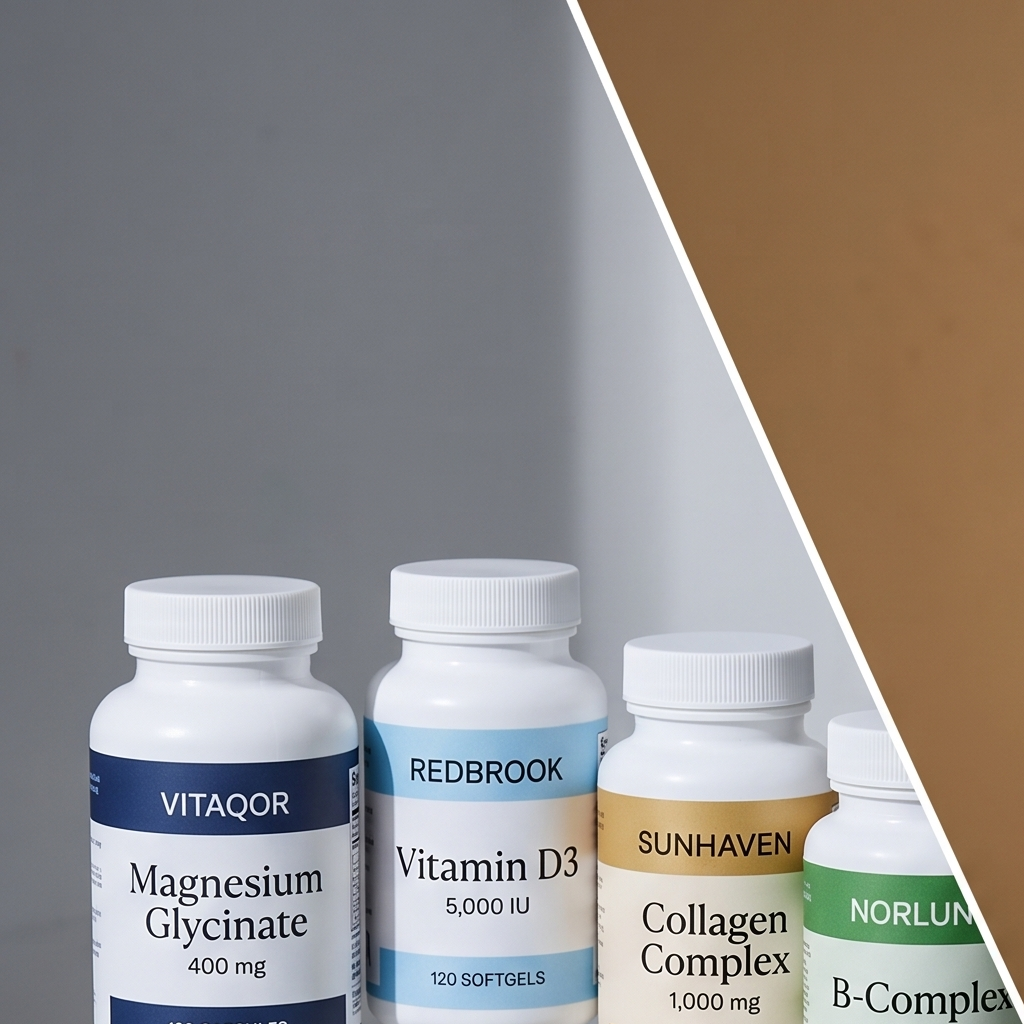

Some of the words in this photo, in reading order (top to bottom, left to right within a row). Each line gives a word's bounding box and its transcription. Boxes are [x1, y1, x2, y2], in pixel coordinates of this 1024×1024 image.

[411, 757, 563, 783] REDBROOK
[161, 792, 289, 821] VITAQOR
[639, 830, 792, 857] SUNHAVEN
[396, 846, 526, 882] Vitamin
[539, 846, 578, 879] D3
[130, 862, 323, 905] Magnesium
[447, 898, 503, 917] 5,000
[511, 897, 529, 914] IU
[852, 899, 973, 926] NORLUN
[146, 908, 307, 949] Glycinate
[643, 902, 787, 944] Collagen
[188, 958, 228, 974] 400
[236, 960, 266, 978] mg
[642, 944, 790, 985] Complex
[431, 972, 456, 986] 120
[461, 971, 545, 987] SOFTGELS
[670, 992, 723, 1012] 1,000
[731, 996, 760, 1015] mg
[833, 977, 1013, 1023] B-Complex
